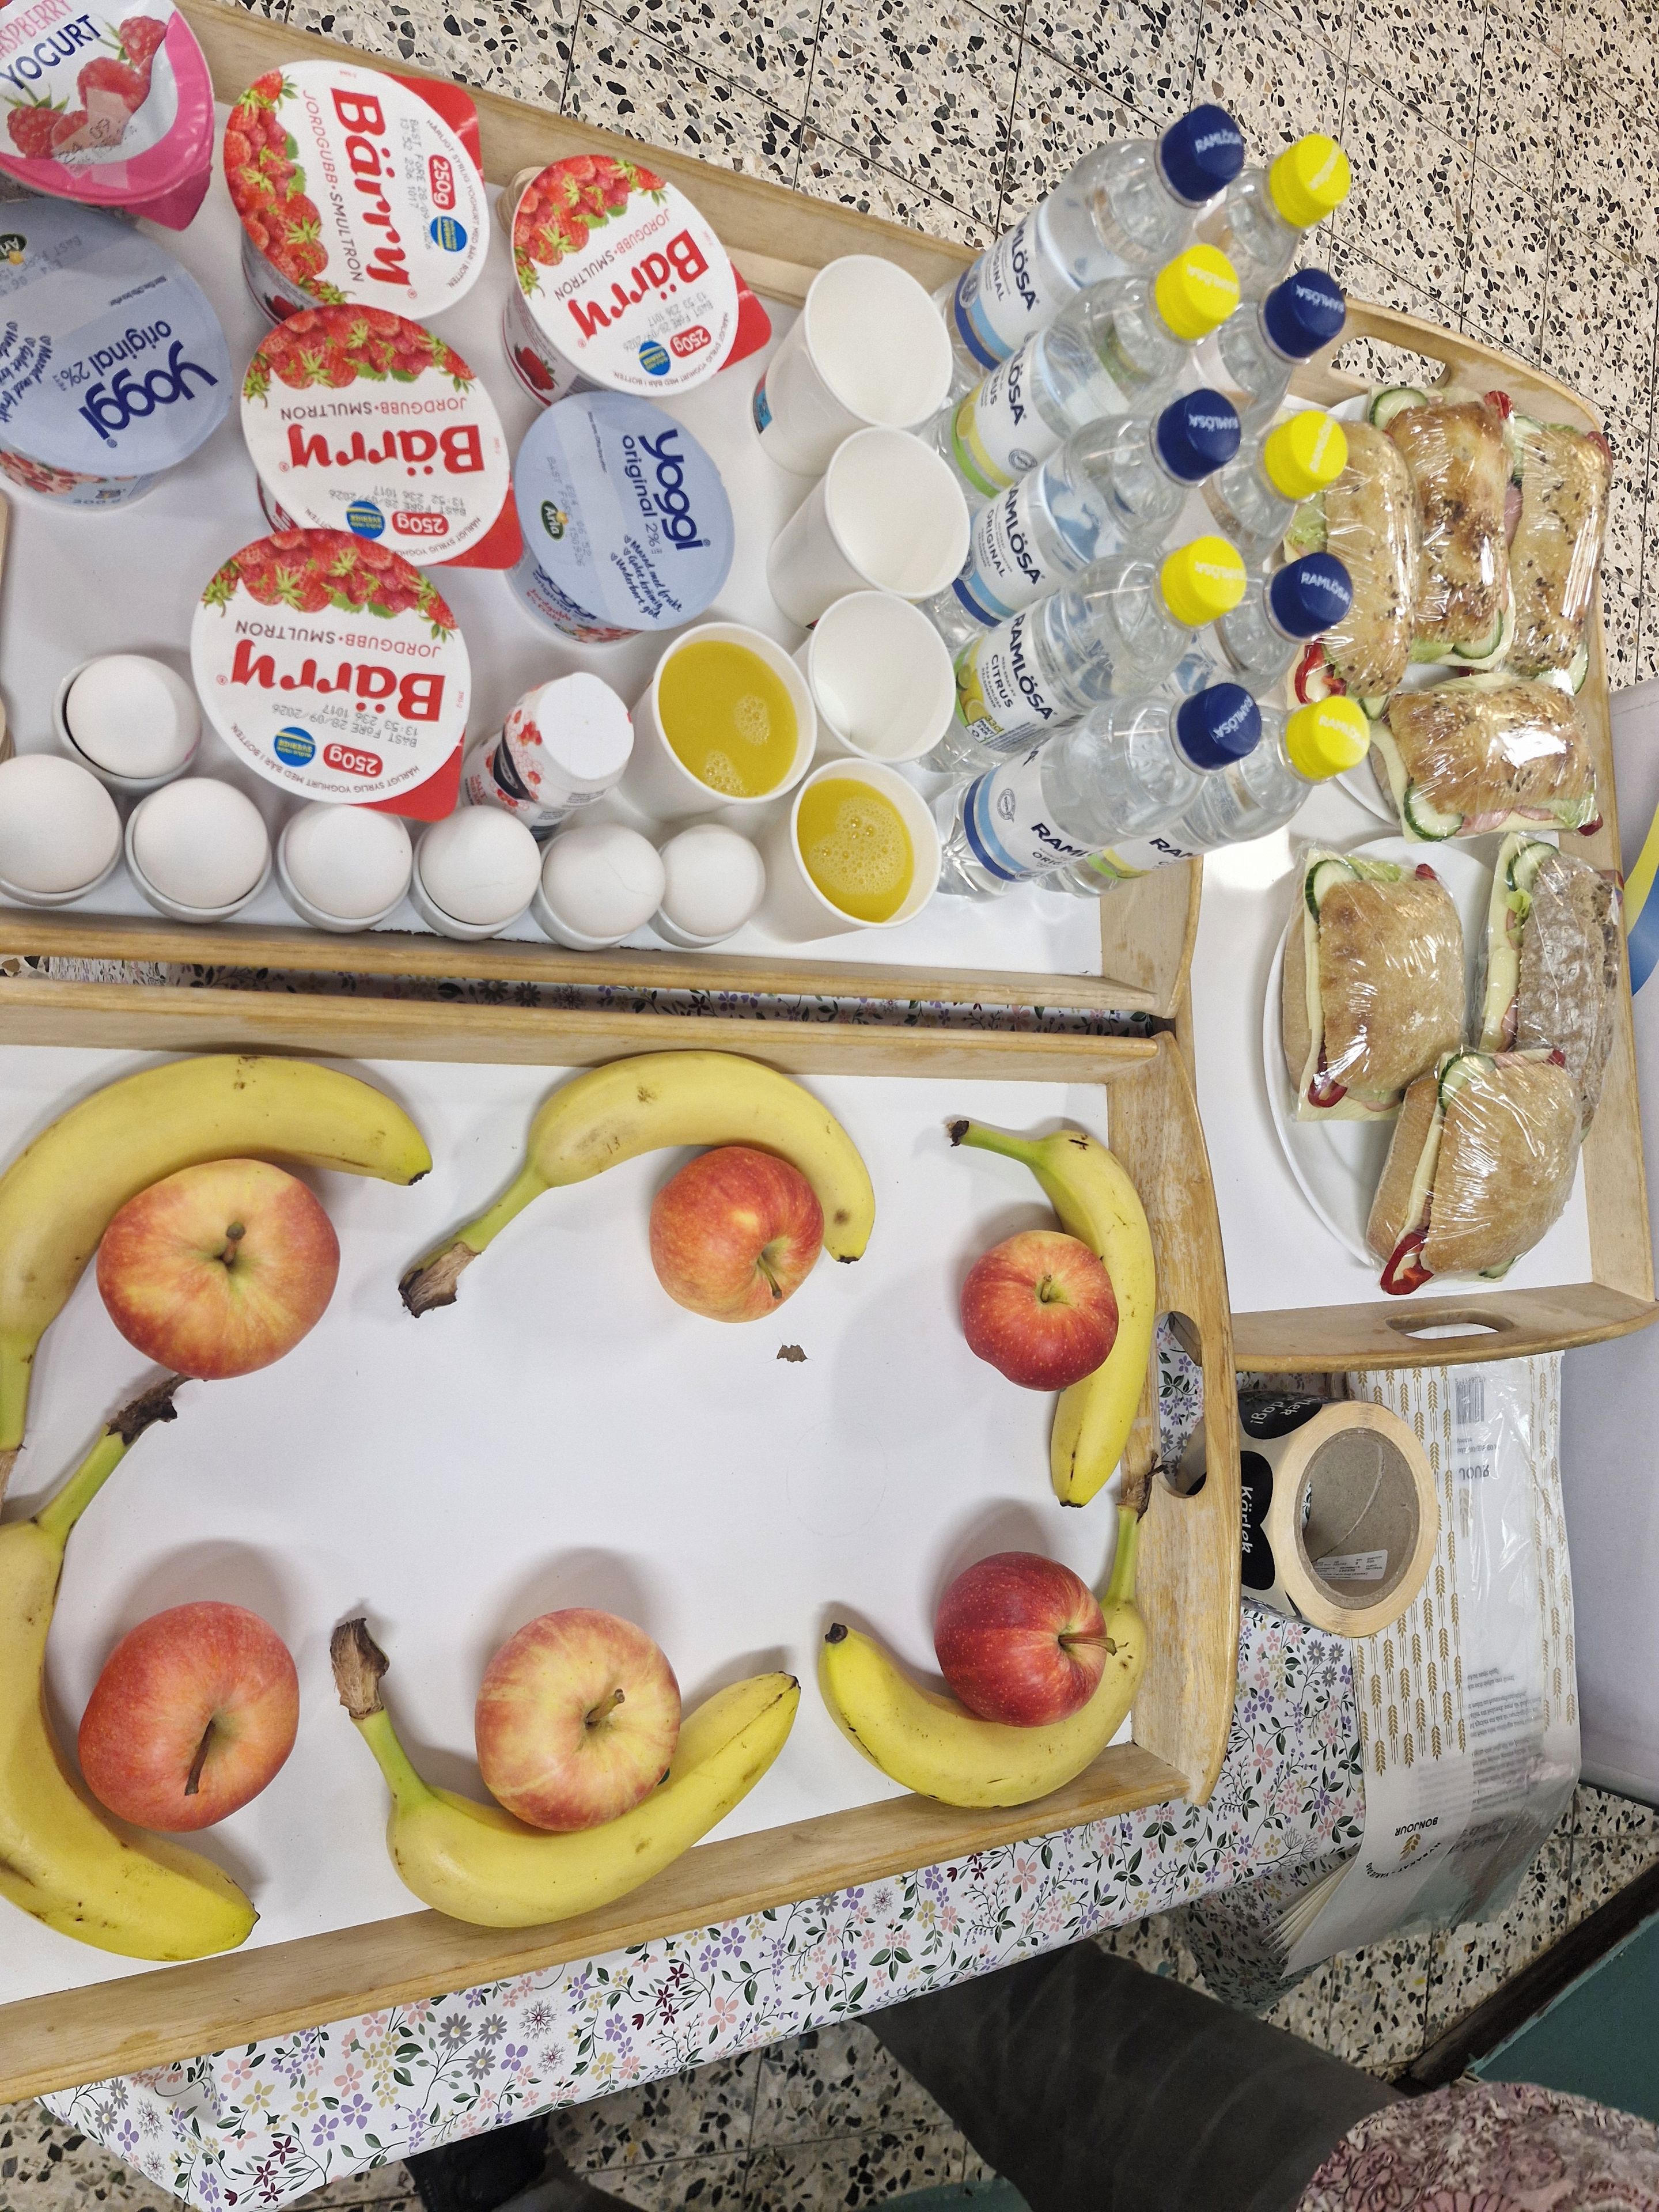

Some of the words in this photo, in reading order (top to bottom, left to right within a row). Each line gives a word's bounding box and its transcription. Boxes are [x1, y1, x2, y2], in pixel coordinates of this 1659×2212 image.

[0, 0, 73, 58] ASPBERRY
[0, 14, 101, 89] YOGURT
[331, 88, 411, 286] Bärry
[431, 160, 451, 206] 250g
[568, 228, 709, 340] Bärry
[89, 320, 172, 377] original
[673, 328, 708, 351] 250g
[60, 361, 91, 388] 2%
[78, 340, 218, 448] yoggi
[287, 423, 484, 476] Bärry
[622, 435, 658, 517] original
[645, 523, 661, 547] 2%
[638, 428, 703, 551] yoggi
[397, 513, 444, 534] 250g
[544, 505, 559, 535] Arla
[987, 509, 1003, 578] ORIGINAL
[651, 569, 664, 585] med
[640, 603, 660, 619] god
[231, 638, 445, 722] Bärry
[991, 654, 1013, 708] CITRUS
[1010, 613, 1053, 720] RAMLÖSA
[323, 703, 349, 719] 1017
[979, 719, 995, 734] PANT
[1213, 695, 1253, 738] RAMLÖSA
[285, 770, 305, 784] MED
[329, 747, 378, 775] 250g
[306, 780, 351, 793] YOGHURT
[354, 782, 385, 793] SYRLIG
[1249, 1401, 1283, 1425] dag!
[1241, 1486, 1253, 1554] Kärlek
[1395, 1817, 1438, 1836] BONJOUR
